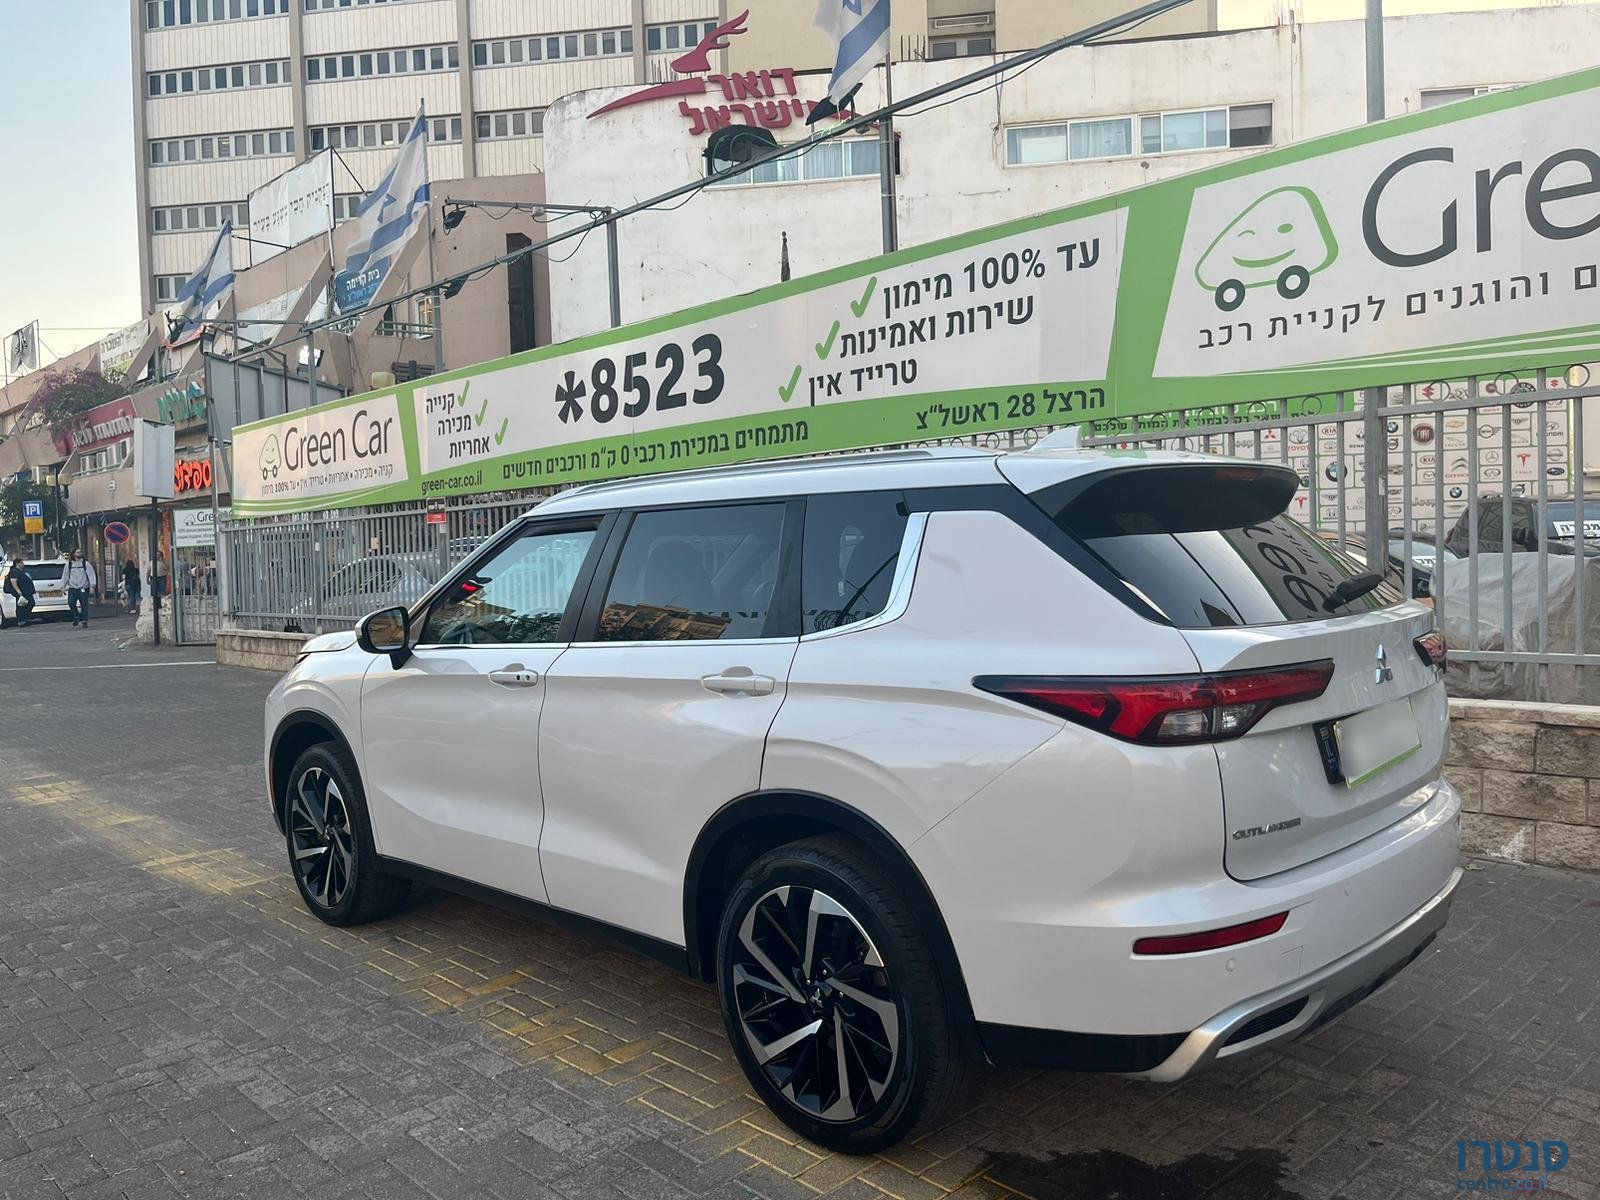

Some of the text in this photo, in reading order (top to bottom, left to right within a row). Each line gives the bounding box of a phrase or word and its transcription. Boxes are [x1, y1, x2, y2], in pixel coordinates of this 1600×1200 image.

[706, 67, 797, 101] דואר
[679, 98, 804, 135] ישראל
[1362, 146, 1600, 268] Gre
[883, 238, 1100, 319] עד 100% מימון
[1406, 271, 1549, 317] והוגנים
[839, 294, 1034, 359] שירות ואמינות
[1267, 295, 1386, 339] לקניית
[1198, 322, 1252, 350] רכב
[808, 358, 918, 407] טרייד אין
[426, 392, 455, 415] קנייה
[1006, 392, 1036, 418] 28
[1042, 387, 1105, 415] הרצל
[437, 414, 472, 436] מכירה
[735, 420, 808, 450] מתמחים
[284, 409, 393, 471] Green Car
[449, 436, 490, 459] אחריות
[632, 442, 666, 464] רכבי
[669, 433, 730, 459] במכירת
[546, 453, 587, 474] ורכבים
[620, 444, 630, 465] 0
[308, 475, 325, 487] טרייד
[328, 470, 350, 484] אחריות
[353, 467, 373, 480] מכירה
[377, 464, 394, 479] קניה
[502, 459, 542, 479] חדשים
[274, 481, 290, 493] 100%
[421, 470, 483, 496] green-car.co.il
